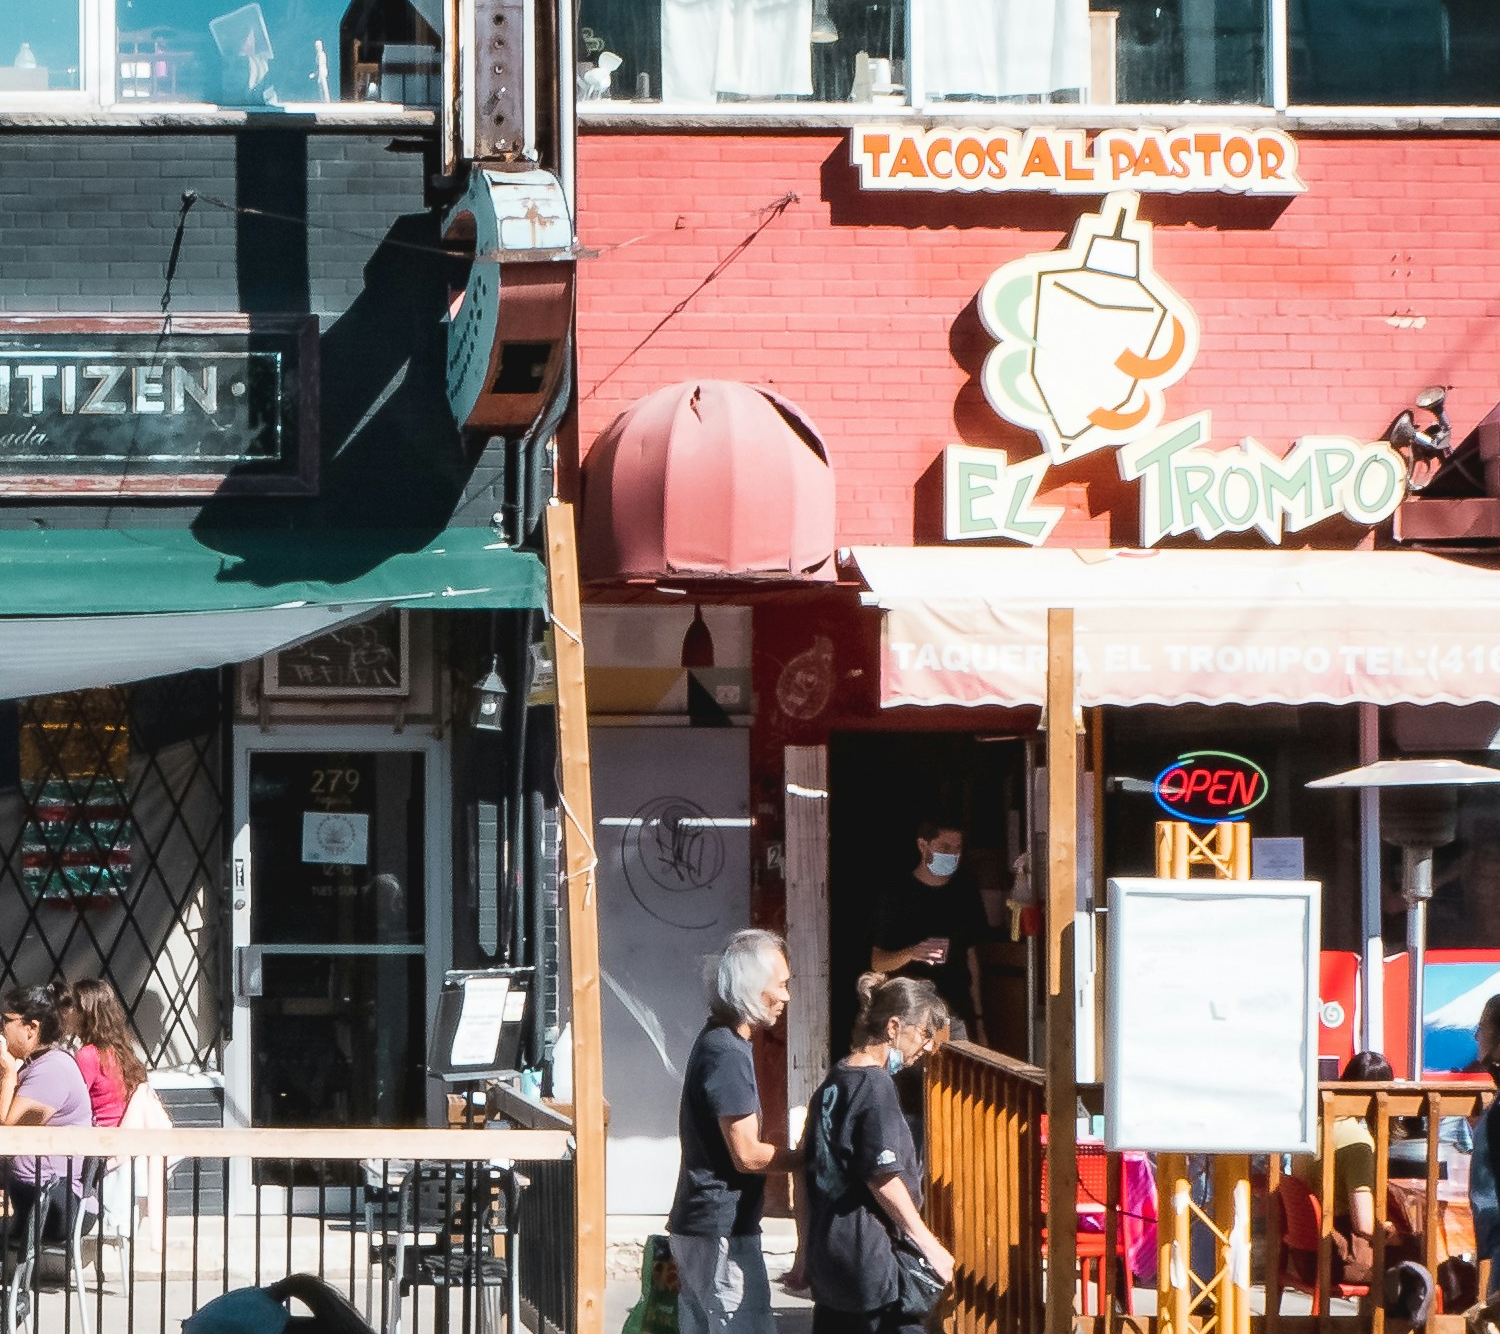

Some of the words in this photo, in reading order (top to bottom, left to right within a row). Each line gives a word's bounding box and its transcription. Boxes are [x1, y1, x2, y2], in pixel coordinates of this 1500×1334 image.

[863, 134, 1008, 179] TACOS
[1021, 136, 1094, 180] AL
[1109, 133, 1286, 180] PASTOR
[959, 462, 1046, 537] EL
[1135, 420, 1396, 534] TROMPO
[891, 643, 1091, 673] TAQUERA
[1105, 644, 1153, 673] EL
[1164, 644, 1331, 673] TROMPO
[311, 769, 360, 793] 279
[1161, 769, 1259, 805] OPEN
